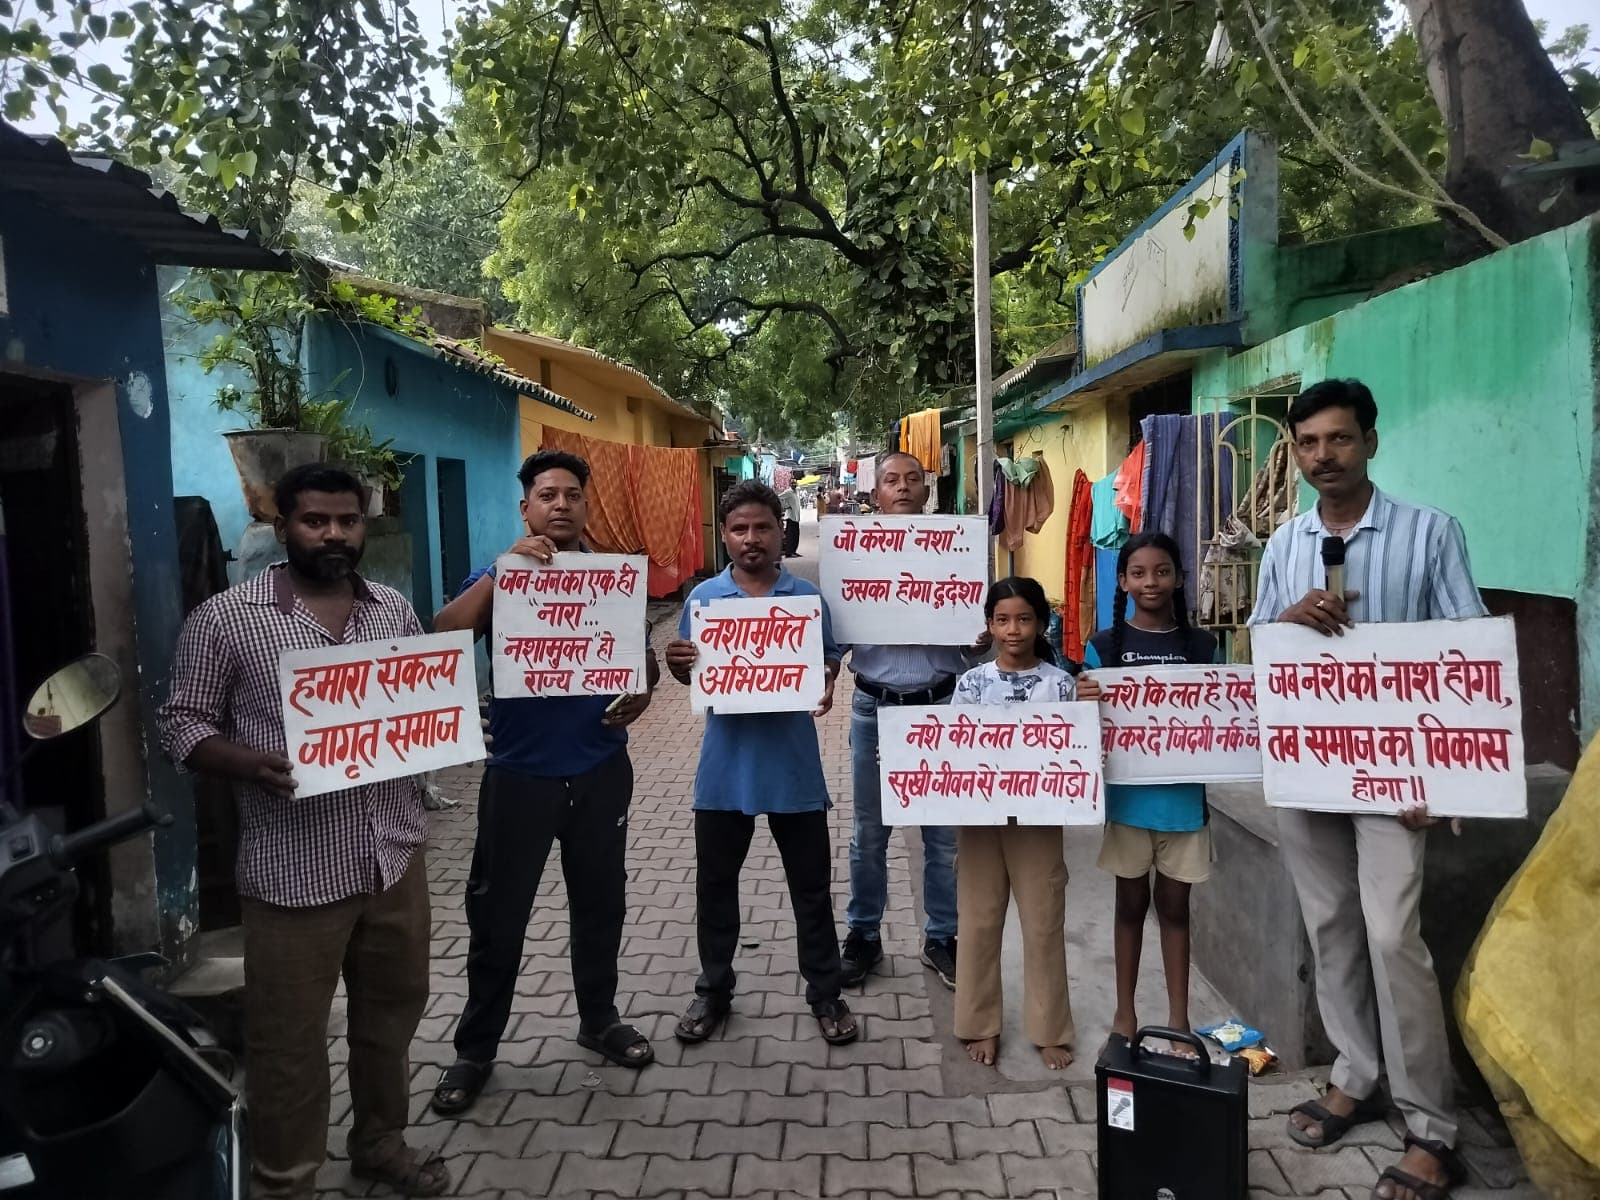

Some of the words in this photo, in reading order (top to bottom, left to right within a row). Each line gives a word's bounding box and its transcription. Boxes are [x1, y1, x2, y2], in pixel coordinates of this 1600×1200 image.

[834, 521, 859, 552] जो
[860, 521, 908, 553] करेगा
[562, 569, 587, 595] का
[588, 569, 615, 599] एक
[617, 562, 639, 597] ही
[842, 579, 892, 603] उसका
[896, 572, 933, 605] होगा
[597, 631, 615, 664] हो
[1121, 651, 1187, 664] Champion
[289, 660, 374, 717] हमारा
[376, 645, 464, 703] संकल्प
[524, 669, 575, 695] राज्य
[699, 655, 809, 696] अभियान
[1101, 676, 1142, 713] नशे
[1142, 675, 1167, 708] कि
[1168, 682, 1204, 710] लत
[1204, 670, 1222, 712] है
[1225, 671, 1257, 712] ऐस
[1268, 663, 1300, 700] जब
[1301, 653, 1345, 705] नशे
[1346, 661, 1377, 702] का
[299, 719, 383, 779] जागृत
[386, 706, 465, 762] समाज
[906, 714, 945, 751] नशे
[949, 713, 978, 749] की
[1118, 726, 1147, 755] कर
[1148, 715, 1166, 757] दे
[1216, 717, 1245, 752] नर्क
[1266, 725, 1300, 764] तब
[1303, 725, 1377, 767] समाज
[1377, 726, 1415, 767] का
[1417, 713, 1513, 772] विकास
[888, 759, 933, 808] सुखी
[932, 761, 977, 798] जीवन
[977, 763, 997, 803] से
